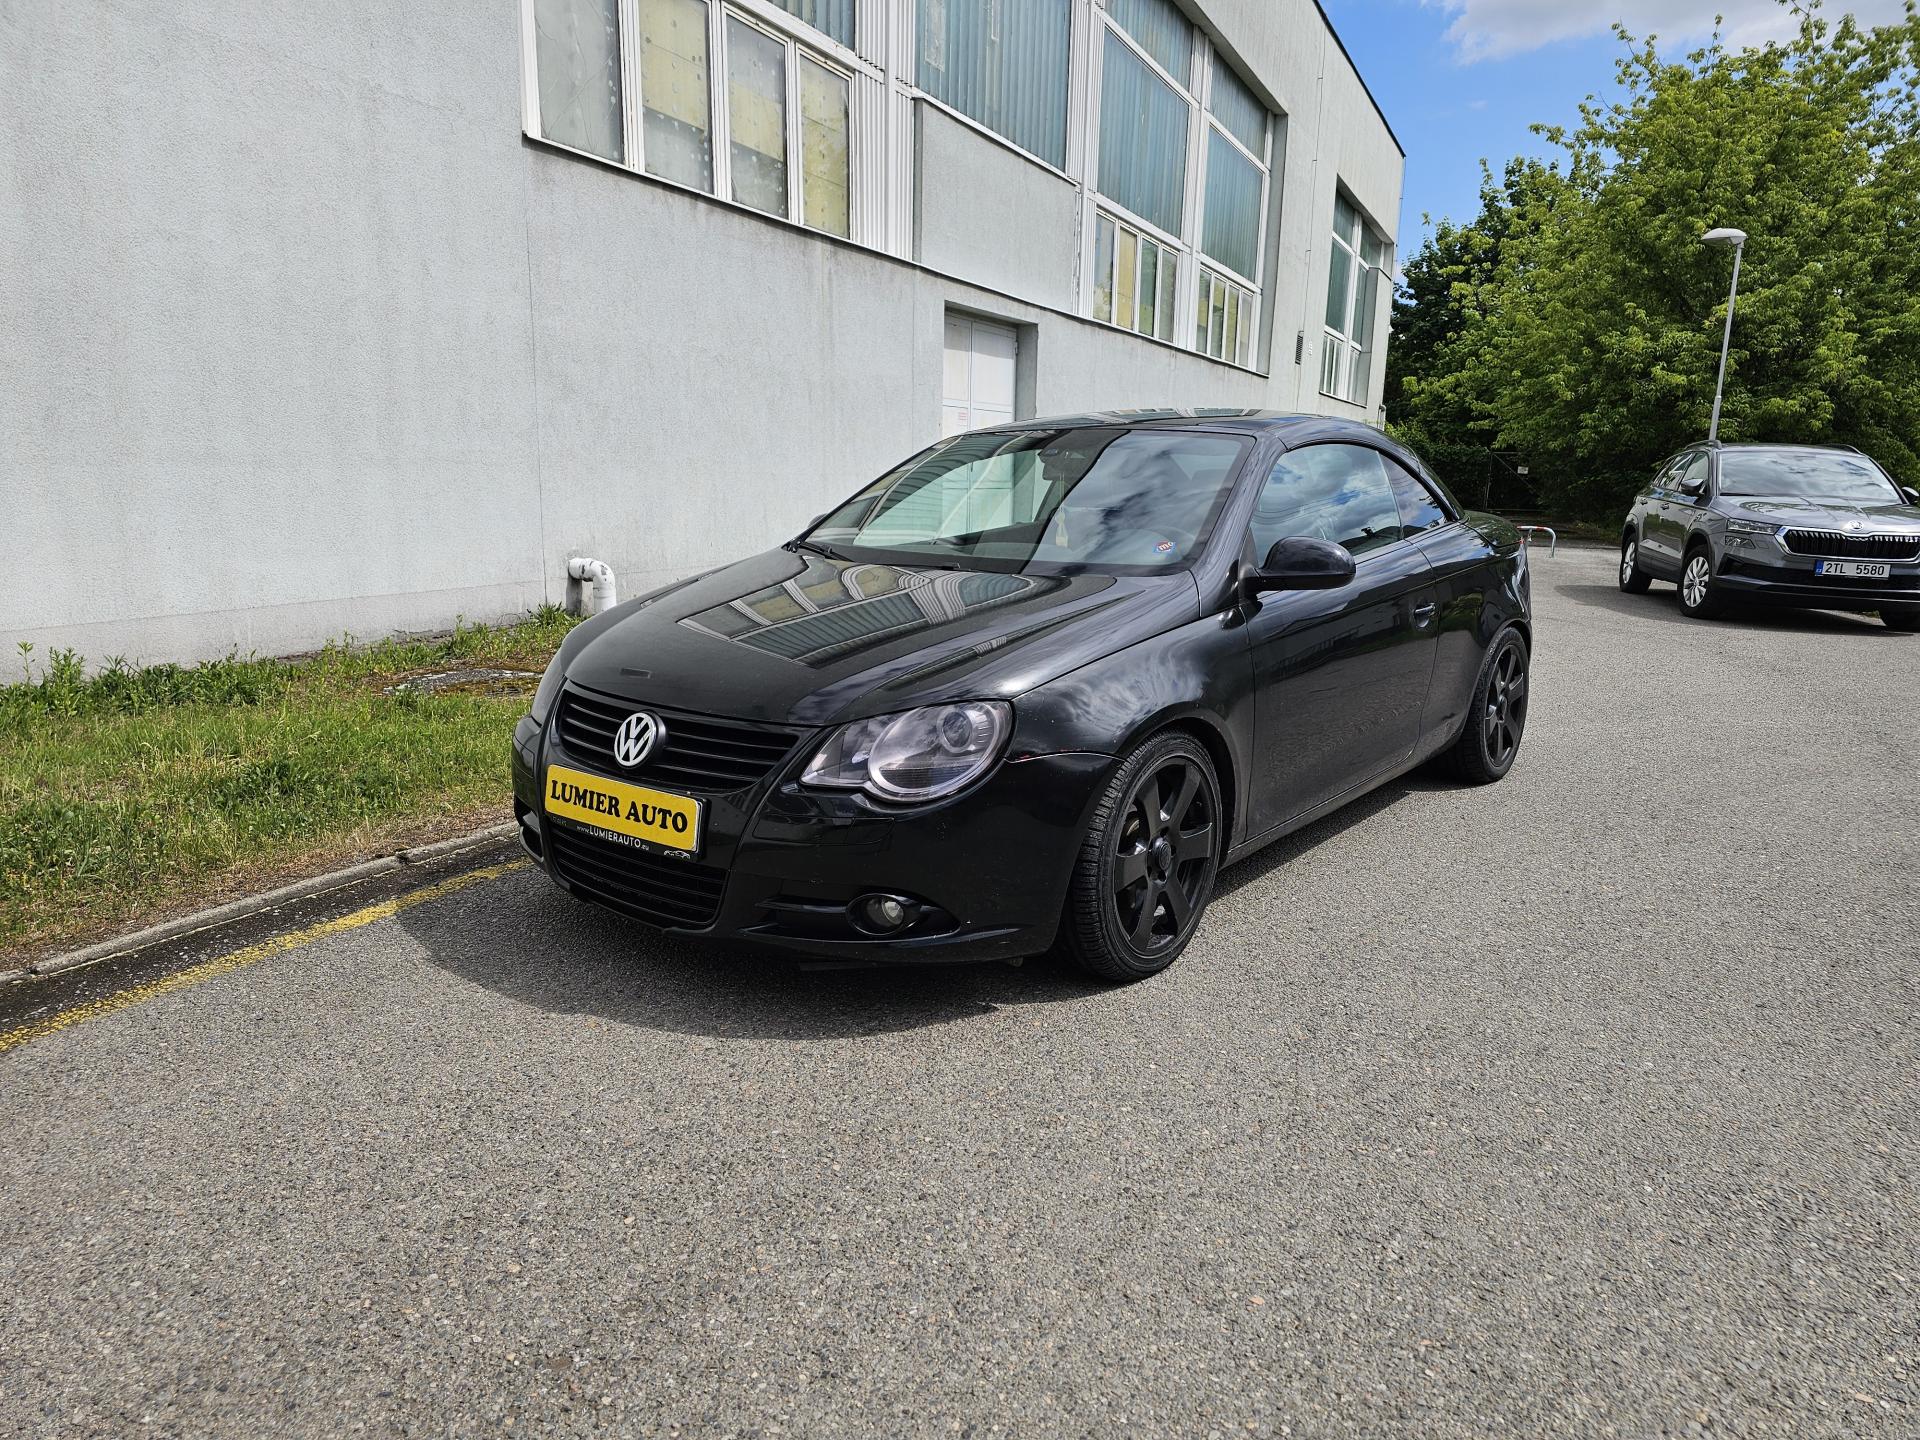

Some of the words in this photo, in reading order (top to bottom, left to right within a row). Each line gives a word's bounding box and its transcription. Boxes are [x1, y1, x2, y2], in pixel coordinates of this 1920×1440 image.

[1825, 562, 1846, 574] 2TL
[1855, 564, 1885, 576] 5580
[550, 779, 621, 818] LUMIER
[625, 801, 688, 834] AUTO
